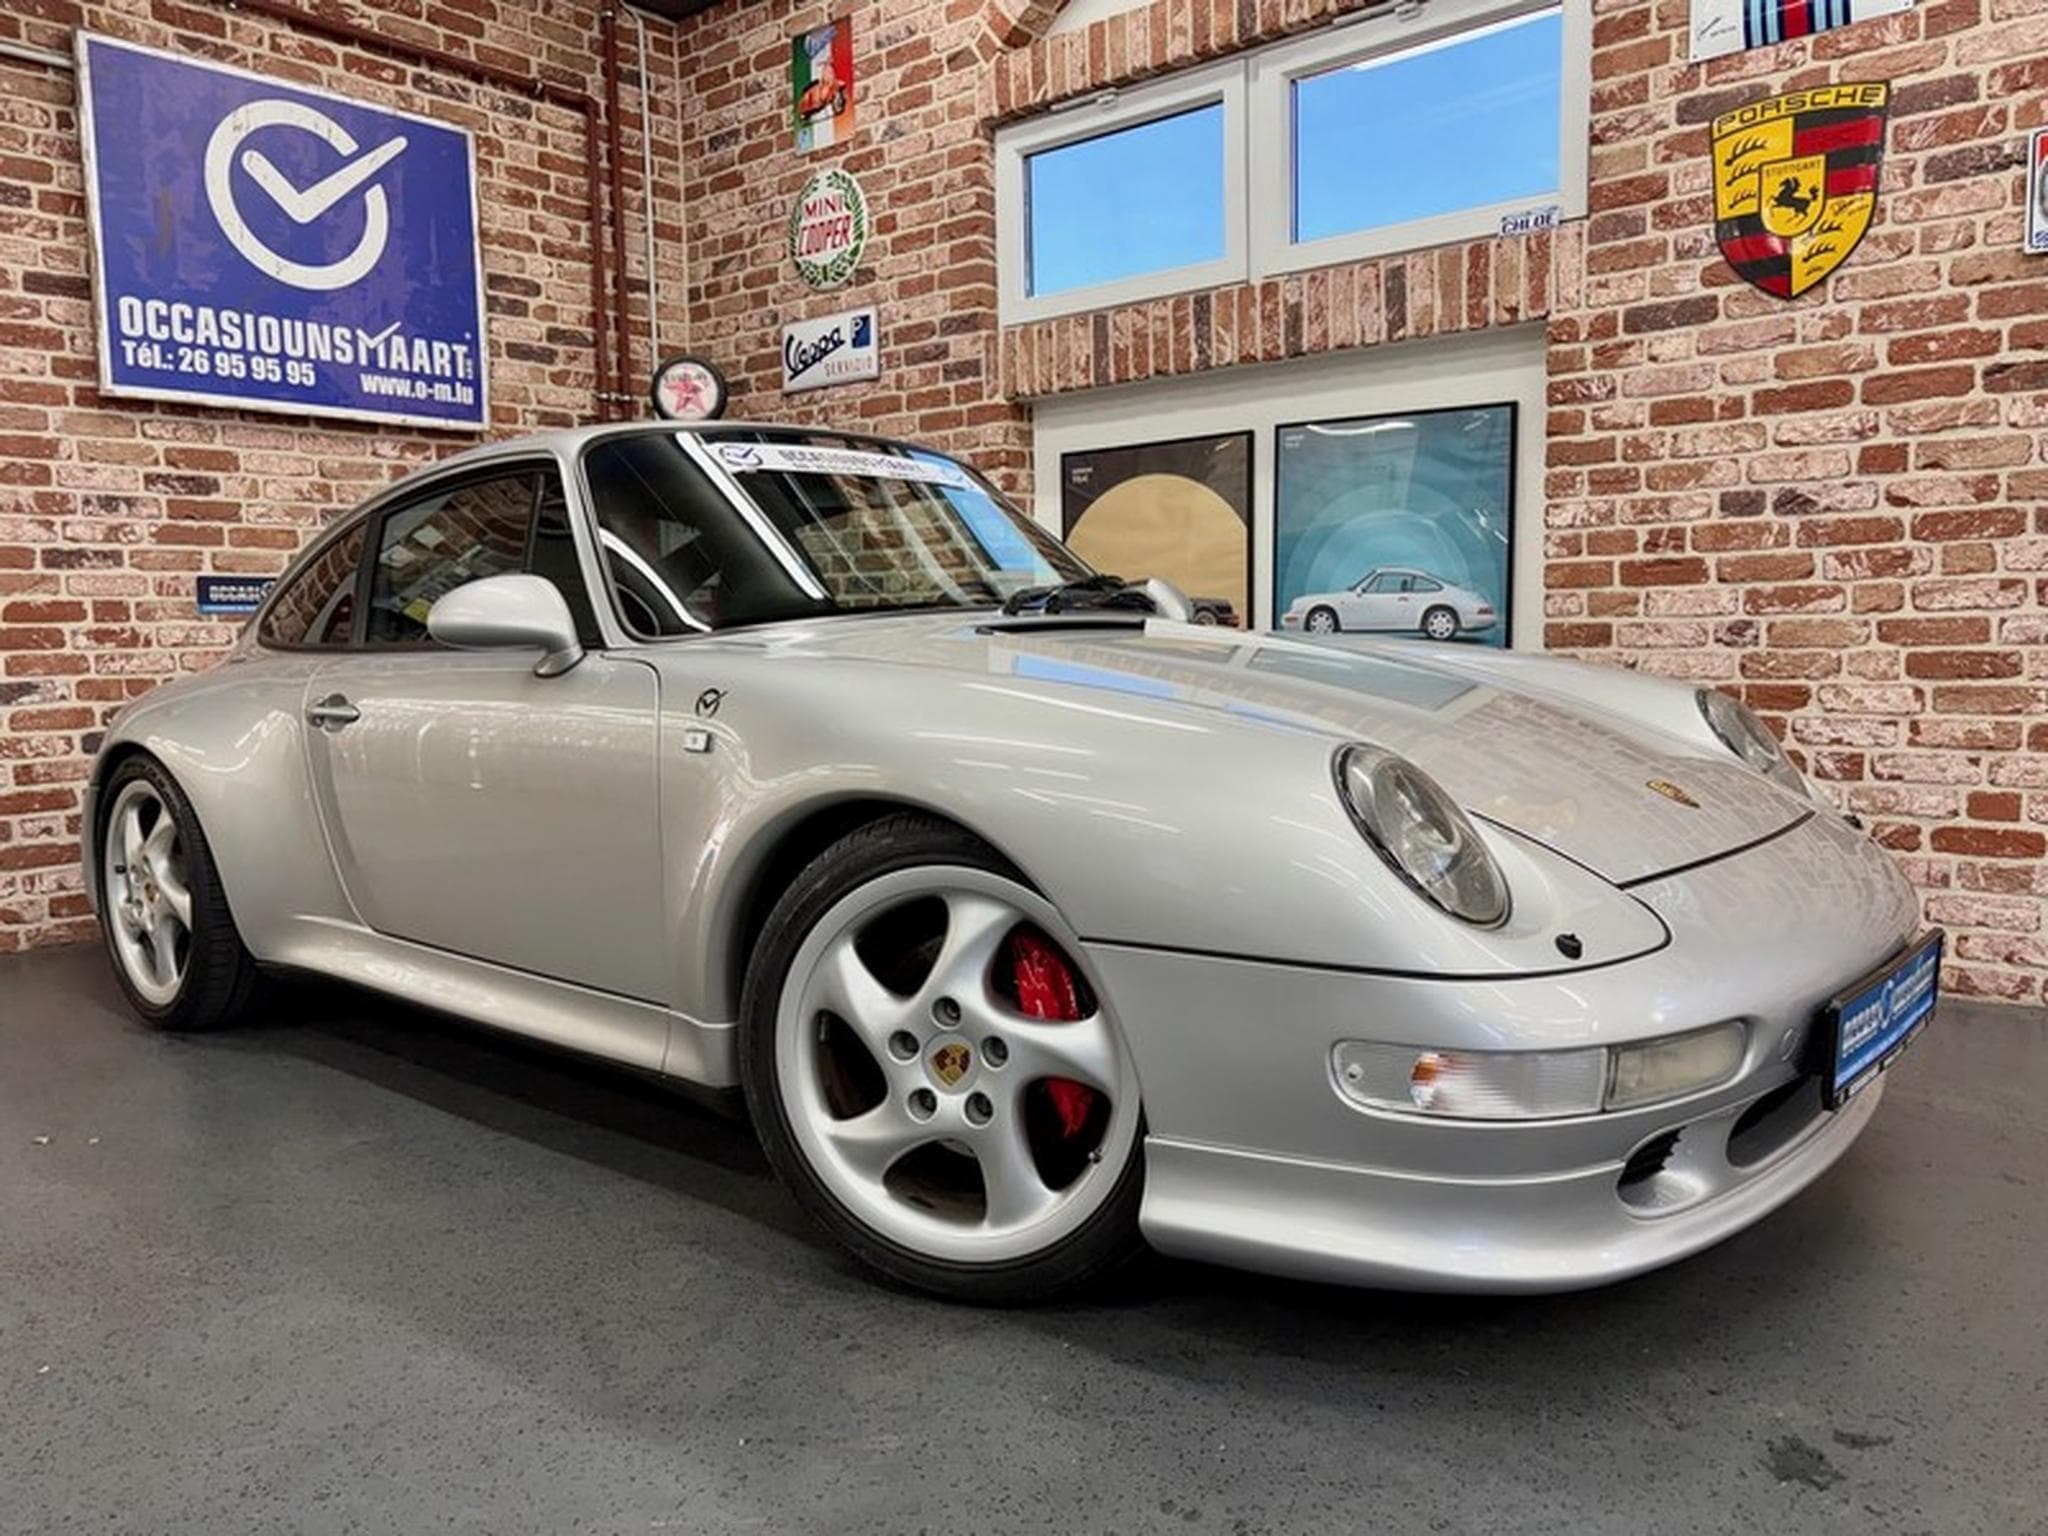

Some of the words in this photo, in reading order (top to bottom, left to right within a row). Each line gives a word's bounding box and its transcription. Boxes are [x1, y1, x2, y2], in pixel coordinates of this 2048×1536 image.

[1717, 86, 1882, 133] PORSCHE
[803, 194, 844, 218] MINI
[798, 214, 851, 256] COOPER
[121, 340, 174, 370] Tél.:
[178, 346, 210, 374] 26
[215, 352, 247, 379] 95
[252, 357, 282, 383] 95
[286, 361, 316, 387] 95
[360, 373, 474, 405] www.o-m.lu
